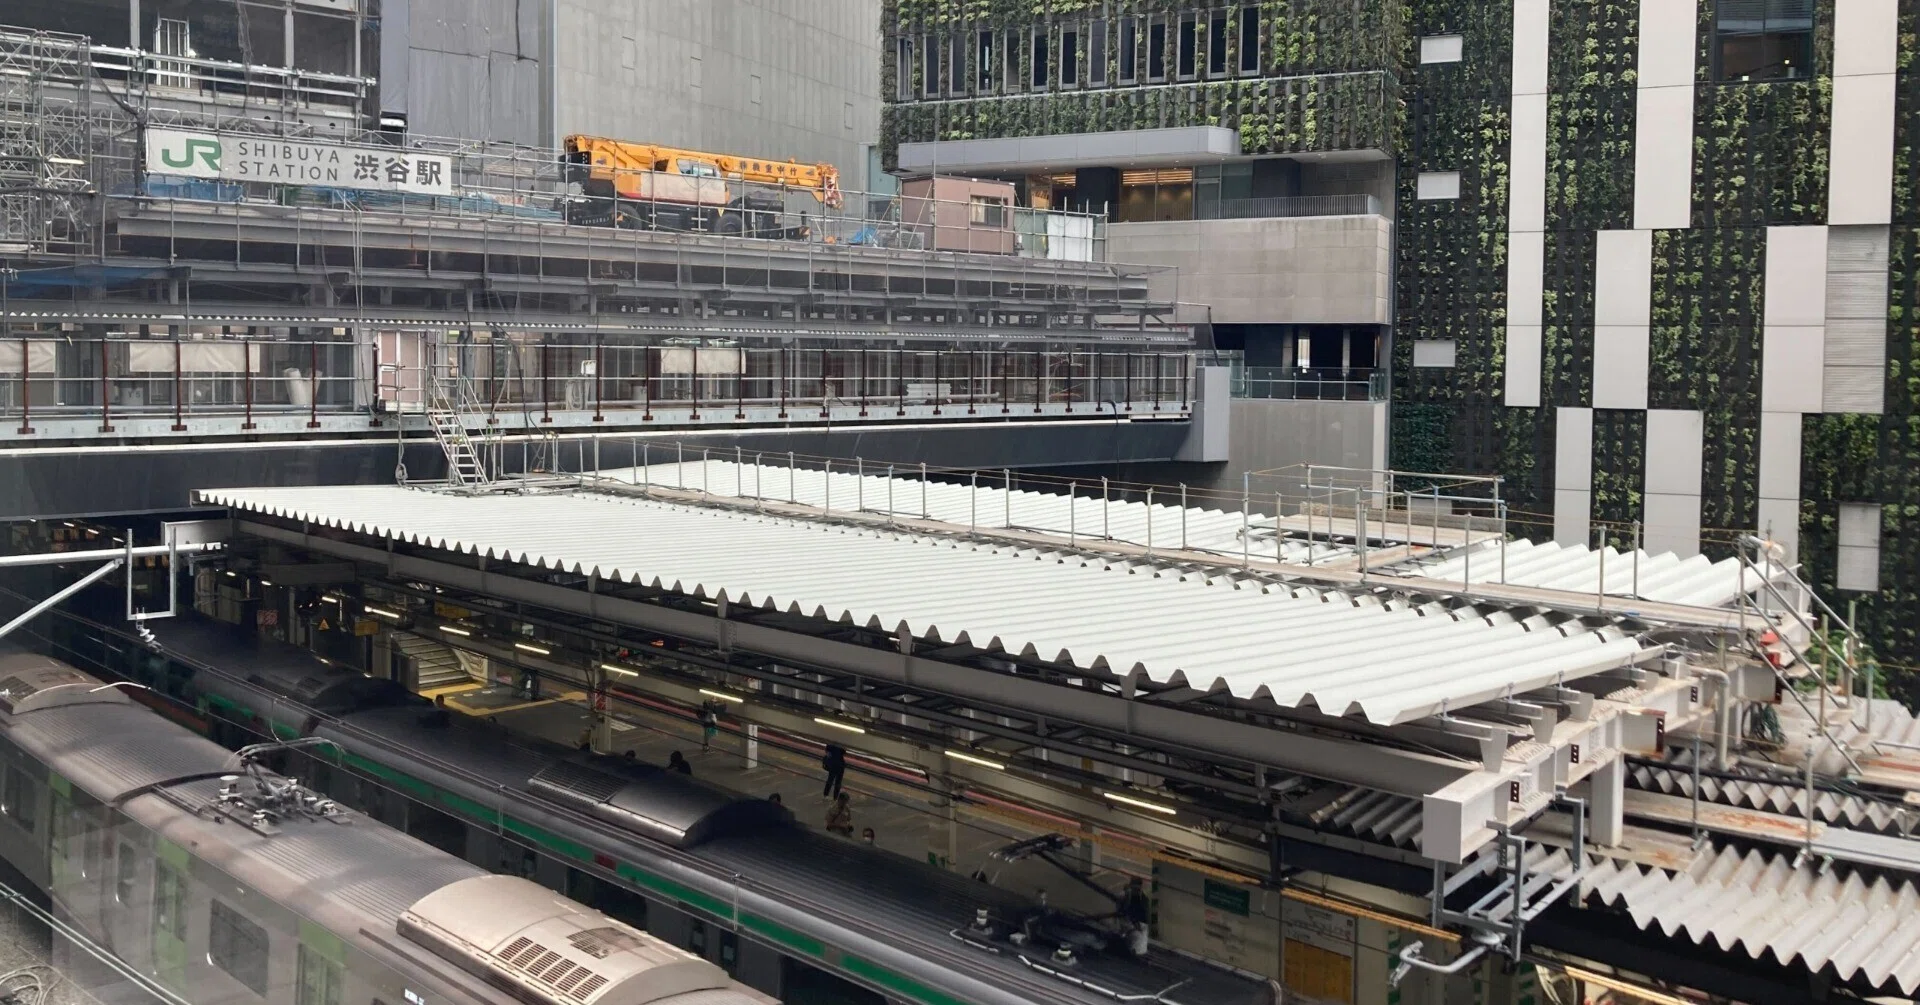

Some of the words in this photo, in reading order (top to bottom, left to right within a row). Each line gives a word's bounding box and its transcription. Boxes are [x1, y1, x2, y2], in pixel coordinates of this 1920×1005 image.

[161, 138, 222, 171] JR
[238, 141, 340, 163] SHIBUYA
[238, 161, 339, 181] STATION
[353, 154, 442, 186] 渋谷駅
